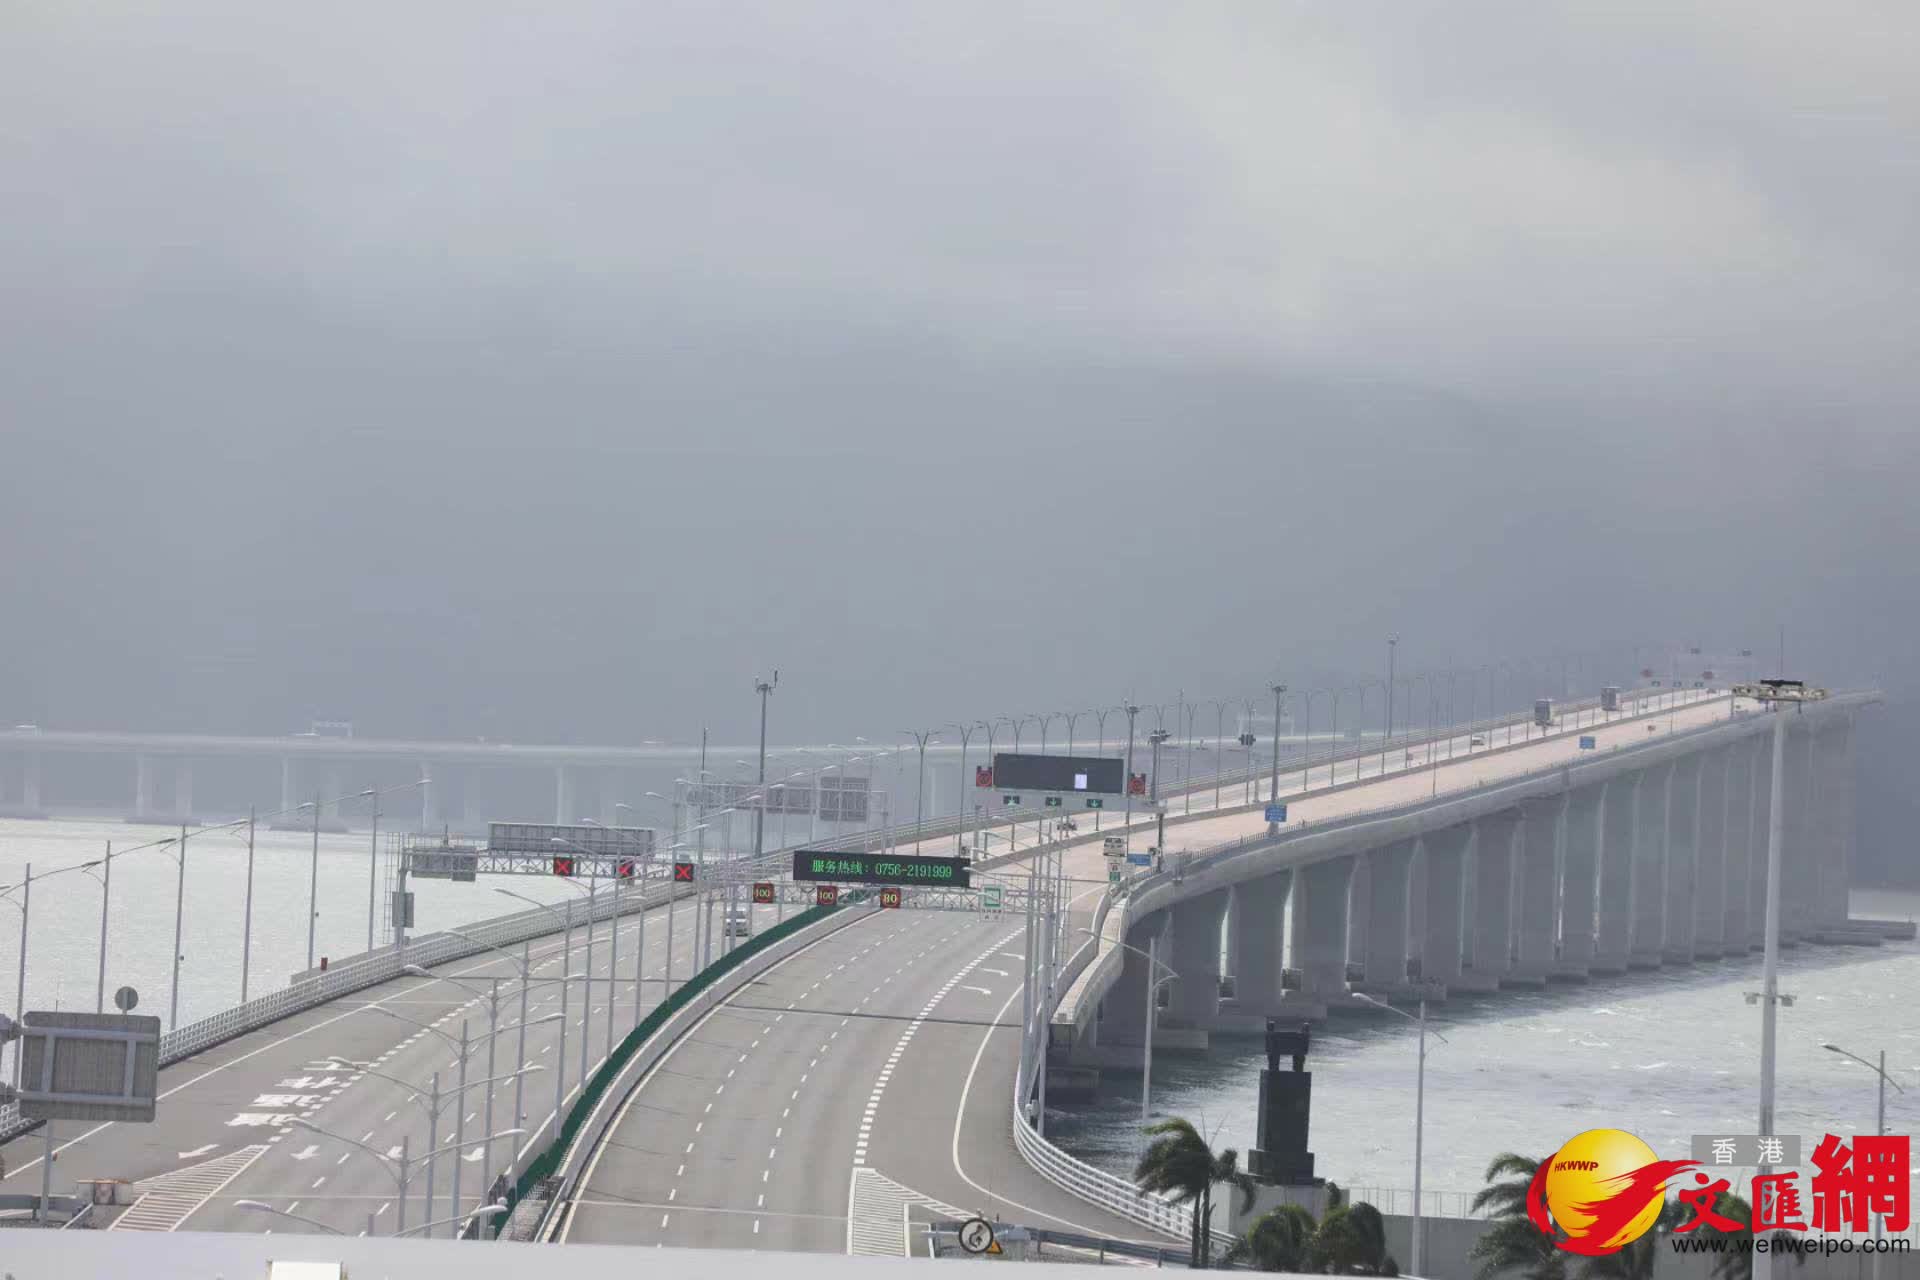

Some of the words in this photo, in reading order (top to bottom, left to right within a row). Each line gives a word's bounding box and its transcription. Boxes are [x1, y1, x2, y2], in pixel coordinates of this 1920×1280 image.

[755, 887, 770, 898] 100
[819, 889, 835, 900] 100
[883, 893, 897, 904] 80
